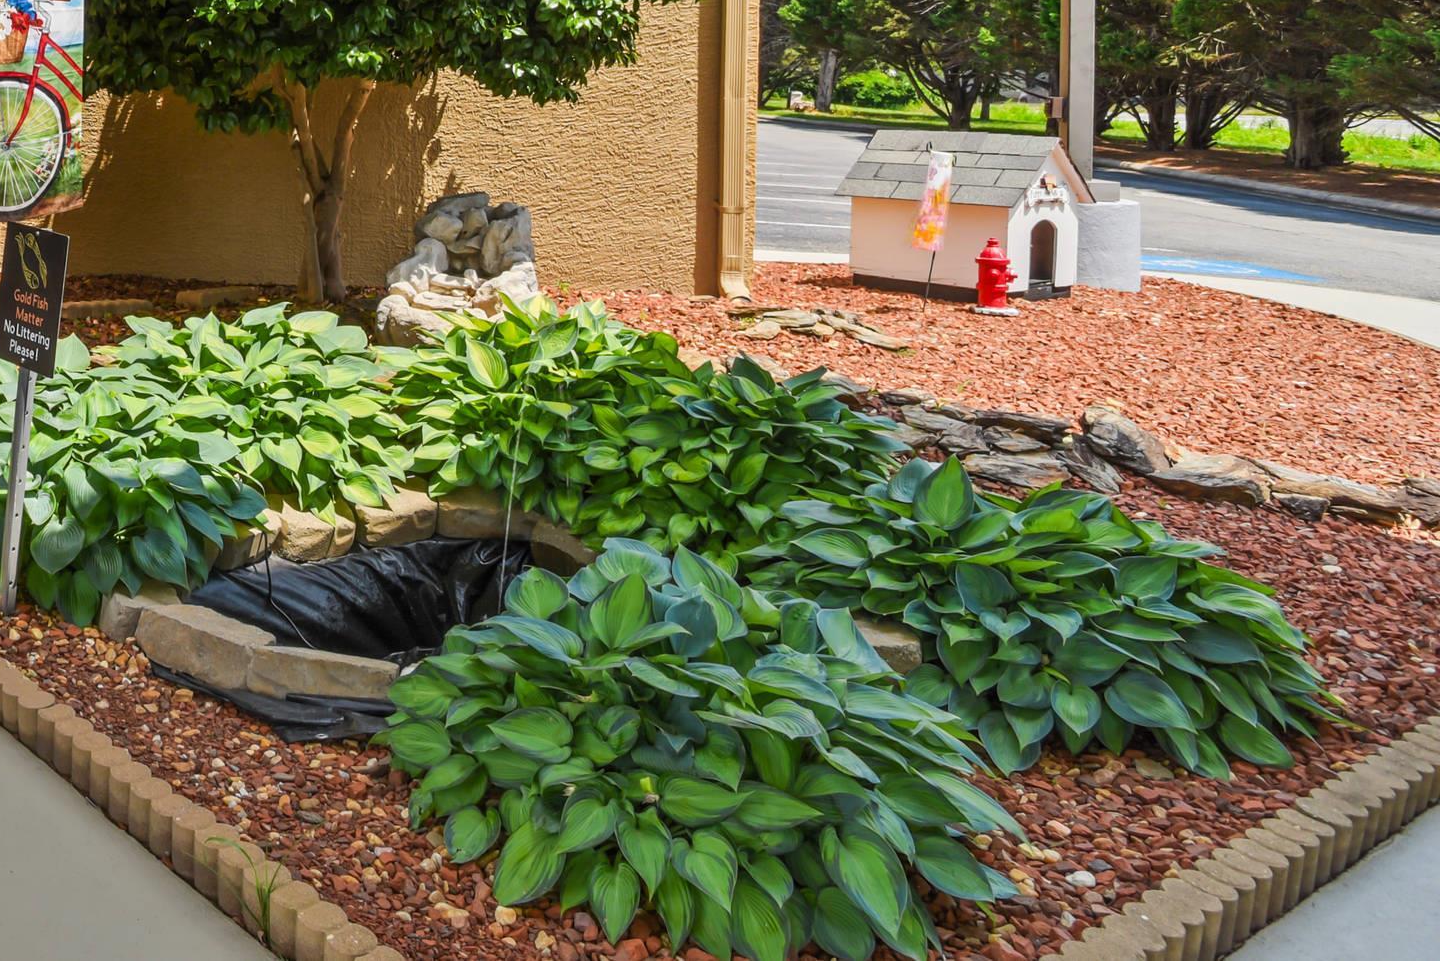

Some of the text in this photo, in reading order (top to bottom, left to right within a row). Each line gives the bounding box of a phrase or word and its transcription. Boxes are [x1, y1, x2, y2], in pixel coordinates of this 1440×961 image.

[14, 289, 48, 310] Gold Fish
[16, 306, 44, 326] Matter
[4, 319, 50, 350] No Littering
